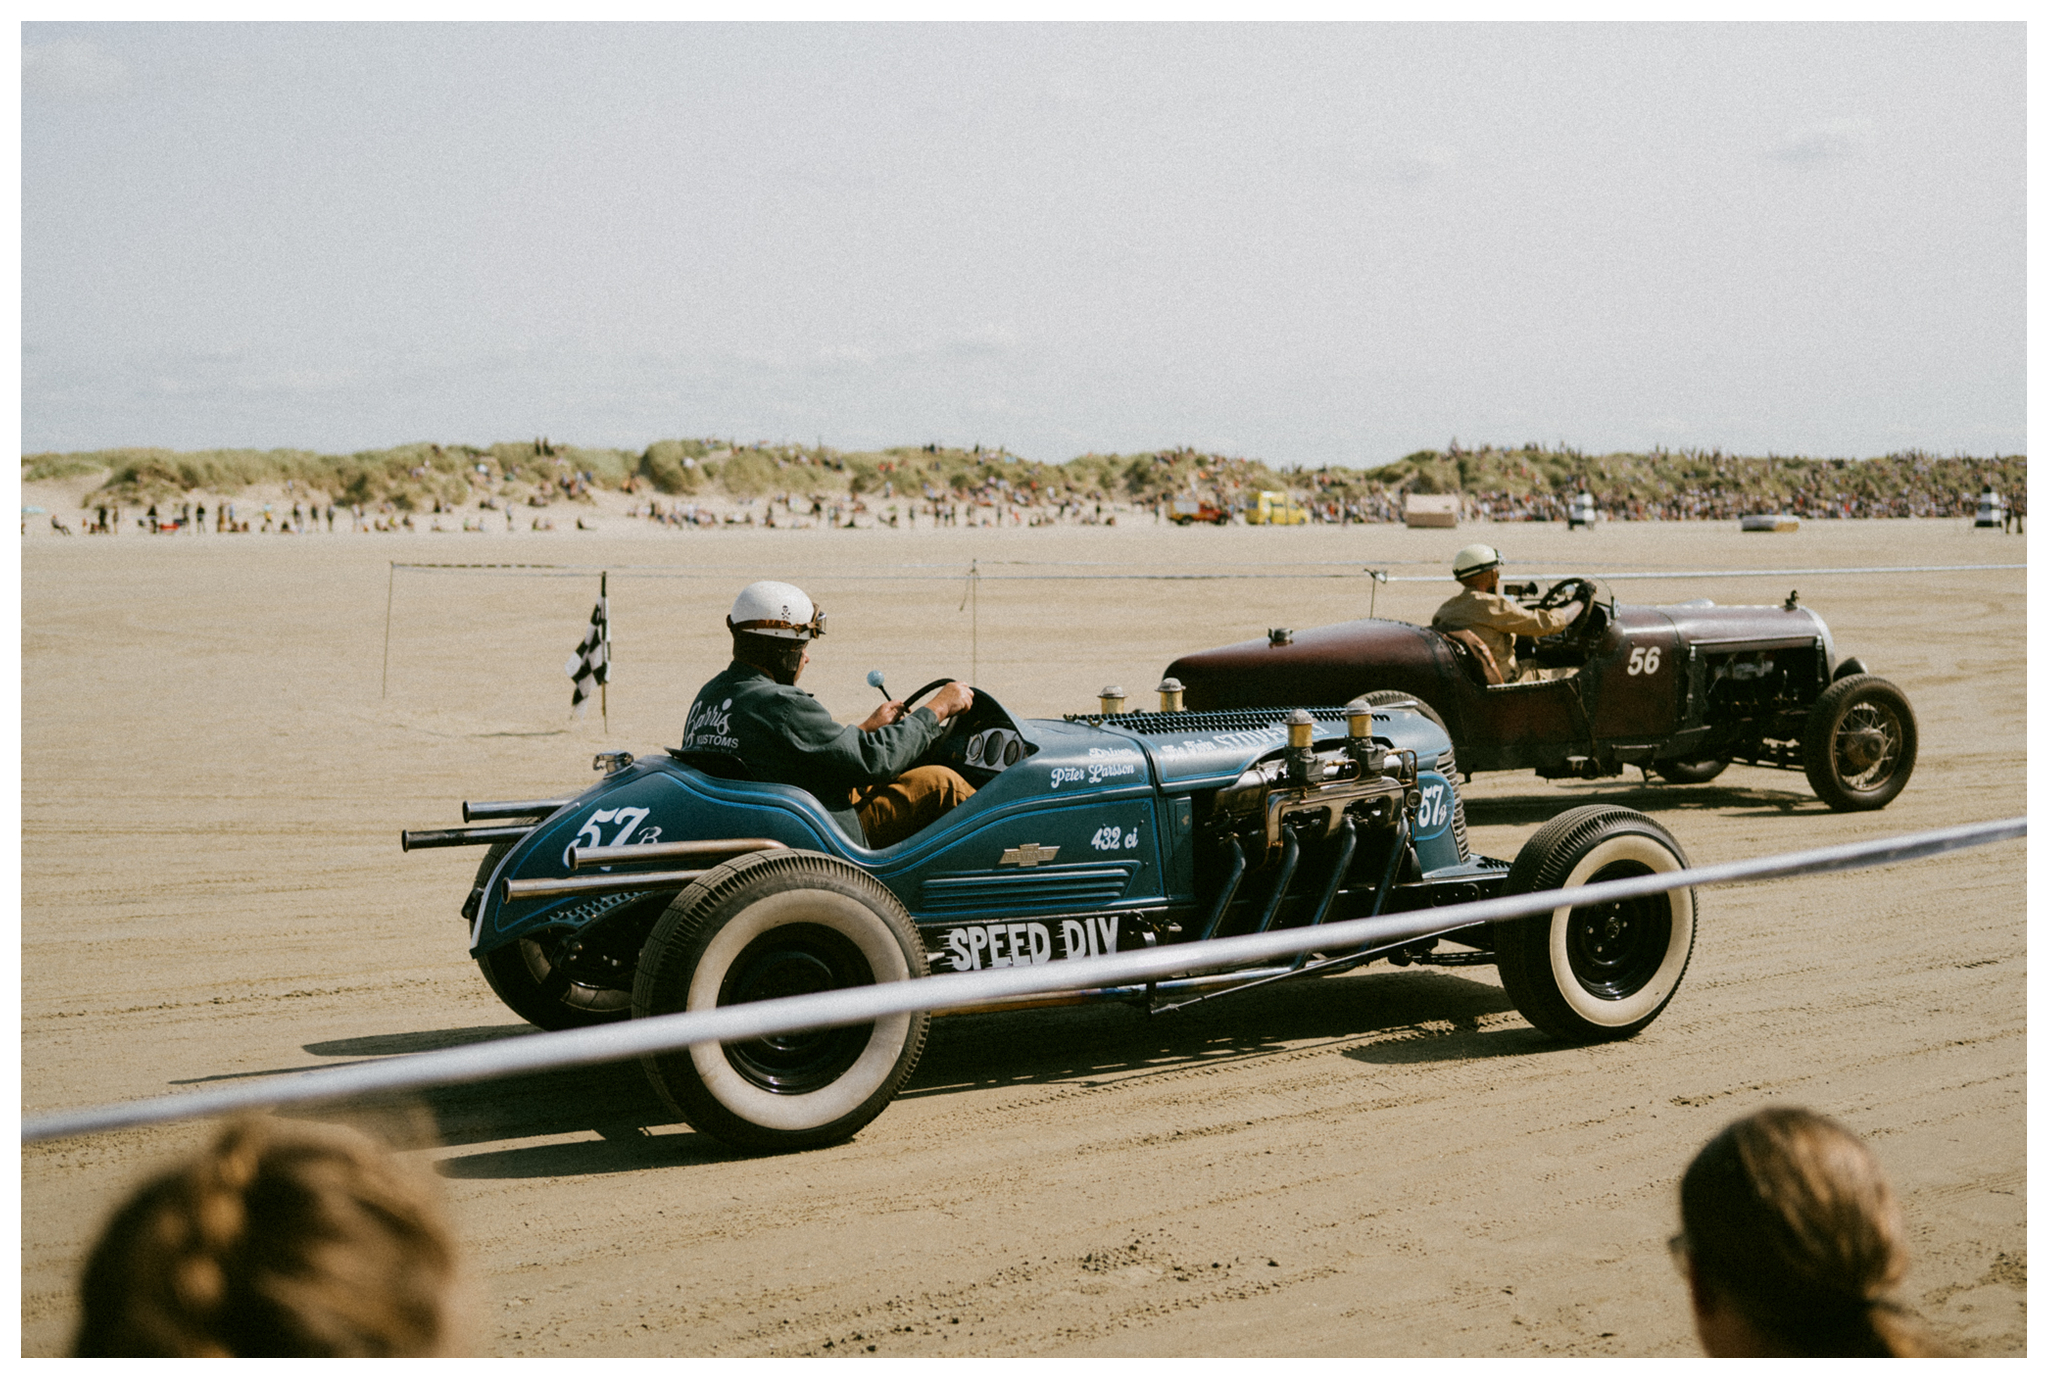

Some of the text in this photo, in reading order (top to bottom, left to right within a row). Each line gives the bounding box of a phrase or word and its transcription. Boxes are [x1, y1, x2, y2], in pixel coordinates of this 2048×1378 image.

[1627, 646, 1661, 676] 56
[1050, 763, 1136, 788] Peter Larsson
[1090, 826, 1139, 850] 432 ci
[945, 922, 1051, 971] SPEED
